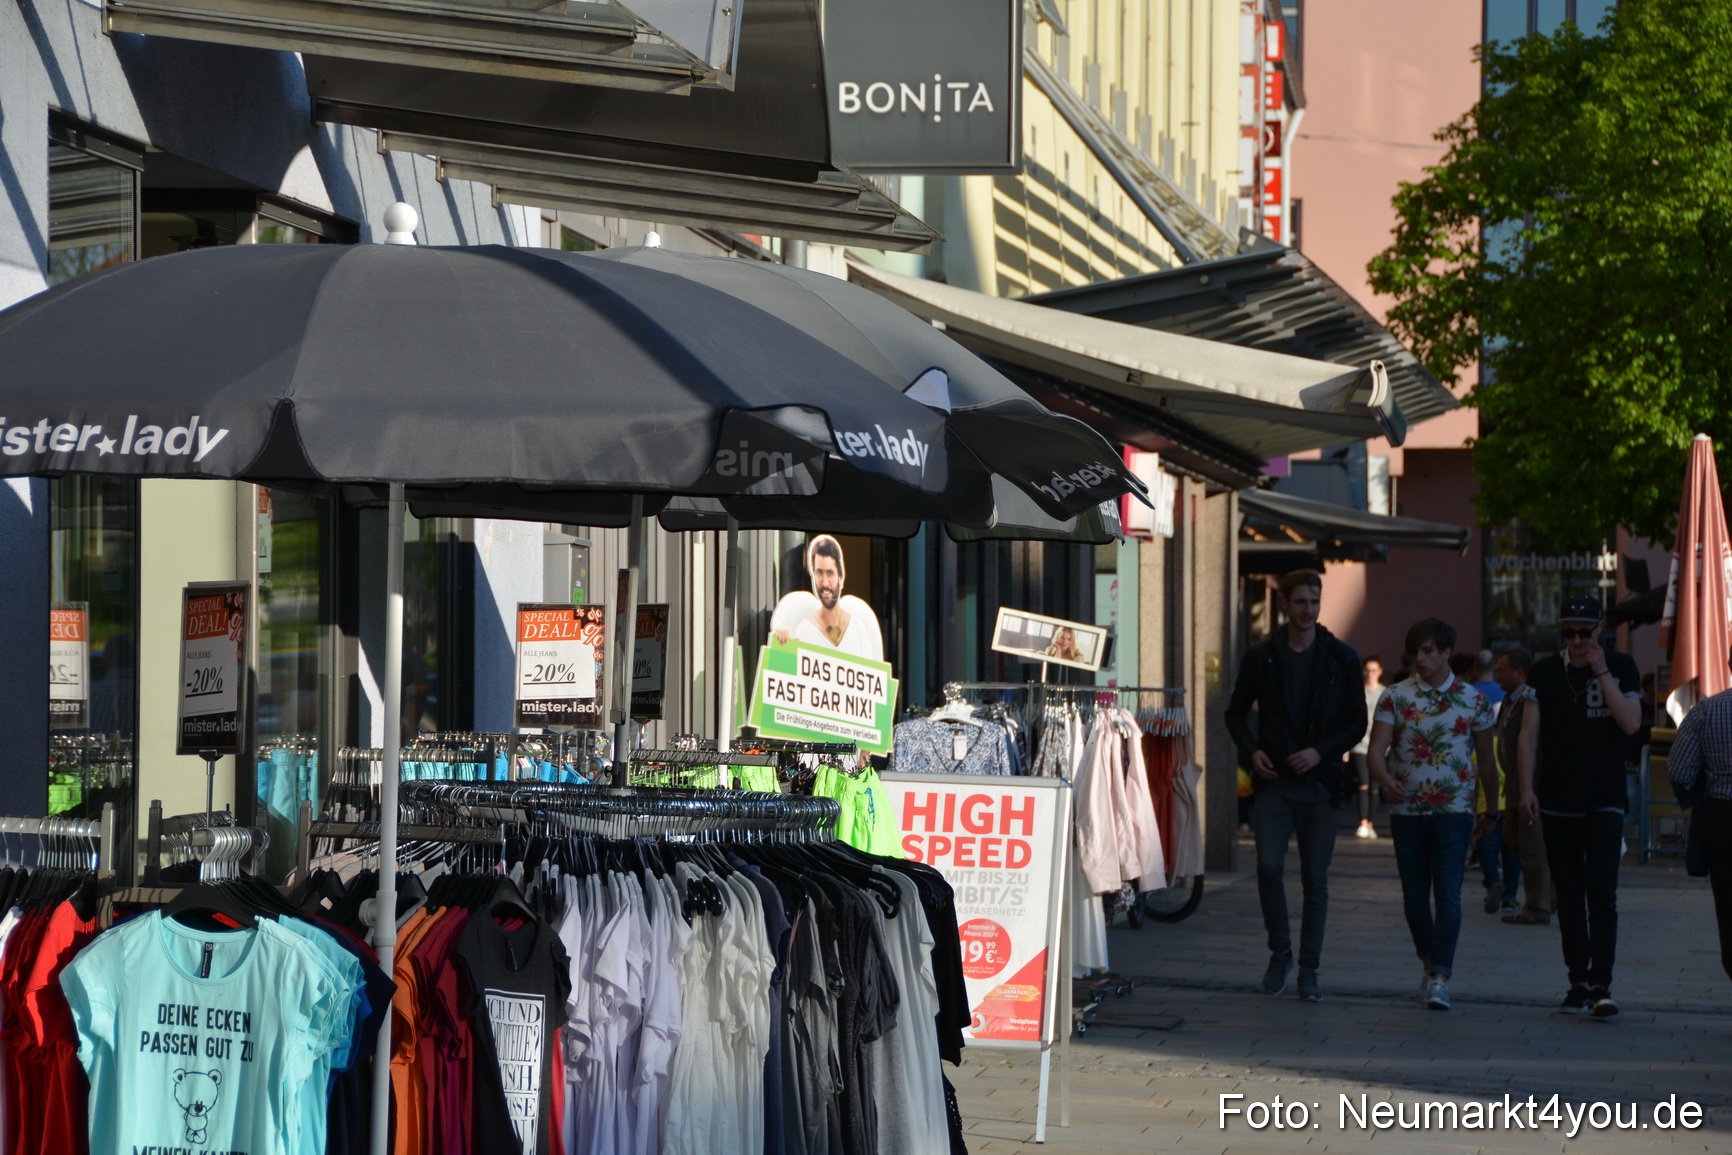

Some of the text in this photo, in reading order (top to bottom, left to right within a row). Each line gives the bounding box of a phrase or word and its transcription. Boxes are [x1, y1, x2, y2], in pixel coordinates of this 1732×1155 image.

[0, 416, 101, 456] ster
[834, 429, 876, 458] ter
[188, 598, 221, 615] SPECIAL
[523, 612, 571, 623] SPECIAL
[188, 613, 227, 636] DEAL!
[523, 622, 579, 639] DEAL!
[538, 650, 558, 658] JEANS
[186, 666, 223, 694] -20%
[524, 662, 576, 683] -20%
[801, 655, 883, 697] DAS COSTA
[767, 677, 873, 720] FAST GAR NIX!
[776, 711, 785, 721] Die
[840, 727, 851, 735] zum
[852, 728, 880, 742] Verlieben.
[901, 791, 1035, 836] HIGH
[901, 834, 1032, 870] SPEED
[945, 870, 1029, 885] MIT BIS ZU
[158, 1003, 251, 1034] DEINE ECKEN
[508, 1000, 541, 1024] UND
[1009, 1017, 1038, 1025] Vodafone
[140, 1030, 254, 1063] PASSEN GUT ZU
